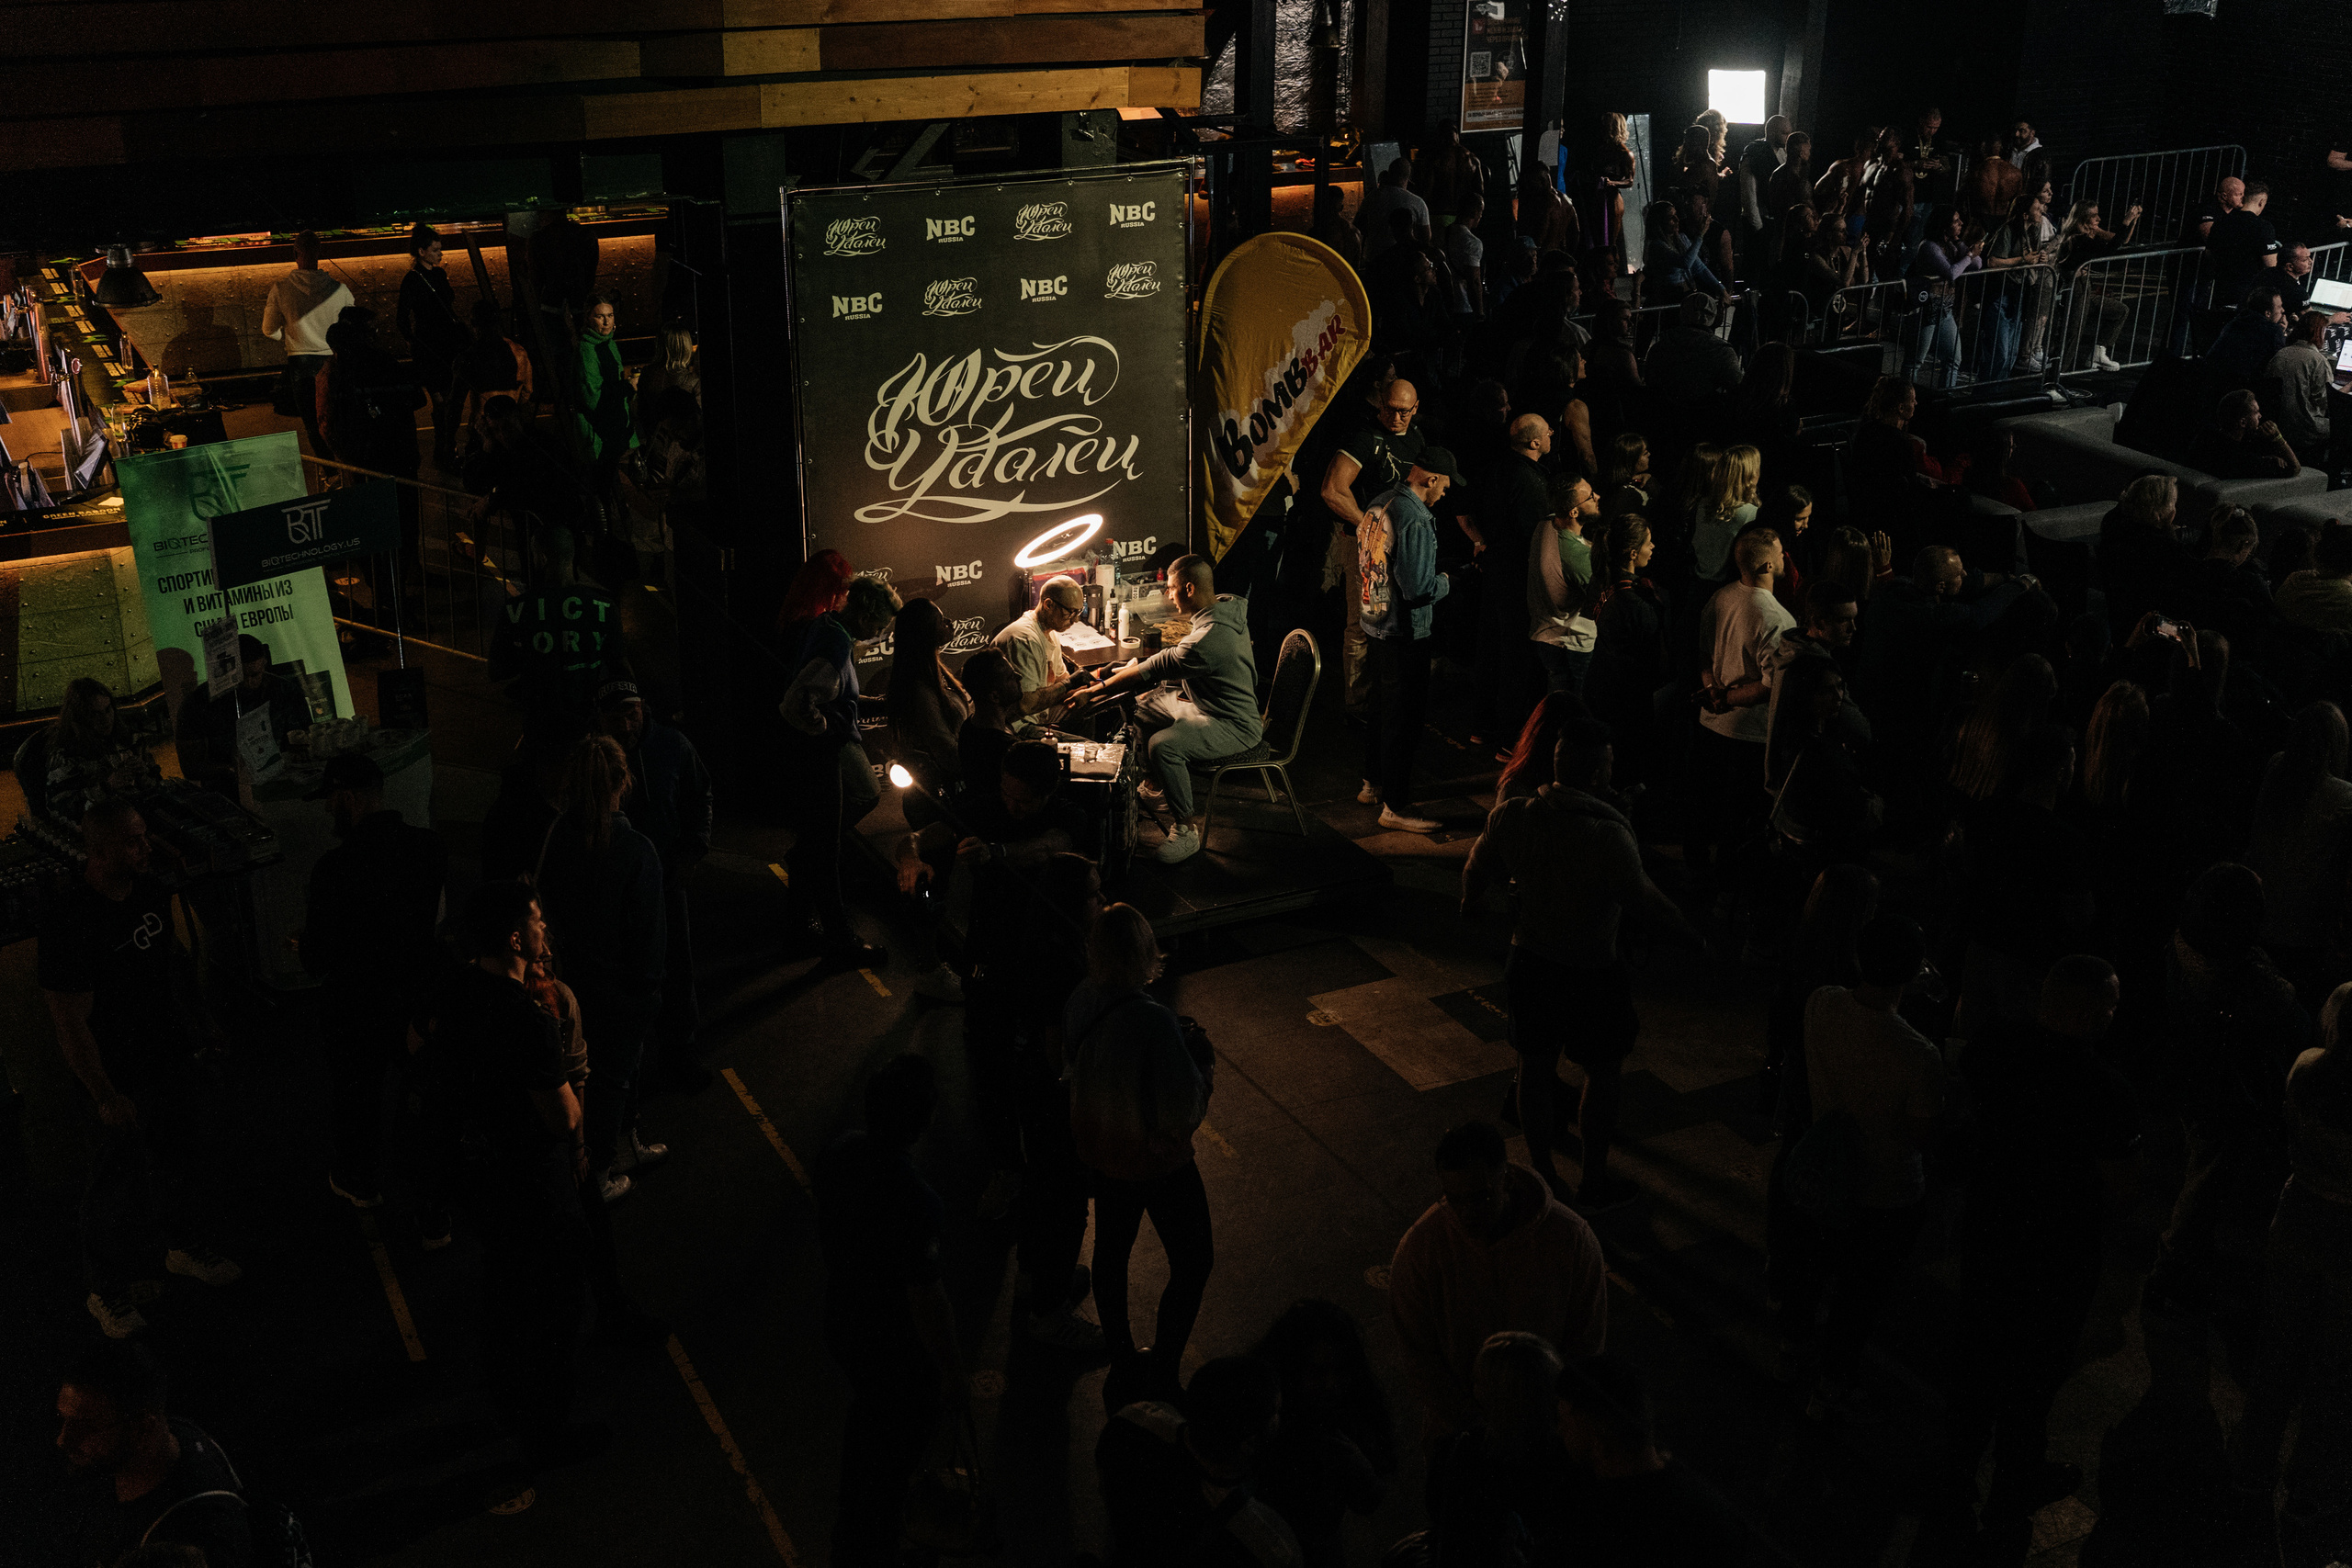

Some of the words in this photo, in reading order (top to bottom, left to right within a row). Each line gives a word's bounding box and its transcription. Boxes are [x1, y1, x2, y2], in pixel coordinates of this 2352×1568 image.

[1110, 201, 1155, 226] NBC
[926, 215, 975, 241] NBC
[1021, 275, 1068, 301] NBC
[831, 292, 883, 319] NBC
[153, 534, 209, 551] BIOTEC
[1113, 536, 1157, 560] NBC
[158, 569, 214, 593] СПОРТИ
[935, 560, 982, 586] NBC
[947, 580, 971, 588] RUSSIA
[184, 598, 195, 615] И
[277, 580, 293, 597] ИЗ
[240, 604, 294, 629] ЕВРОПЫ
